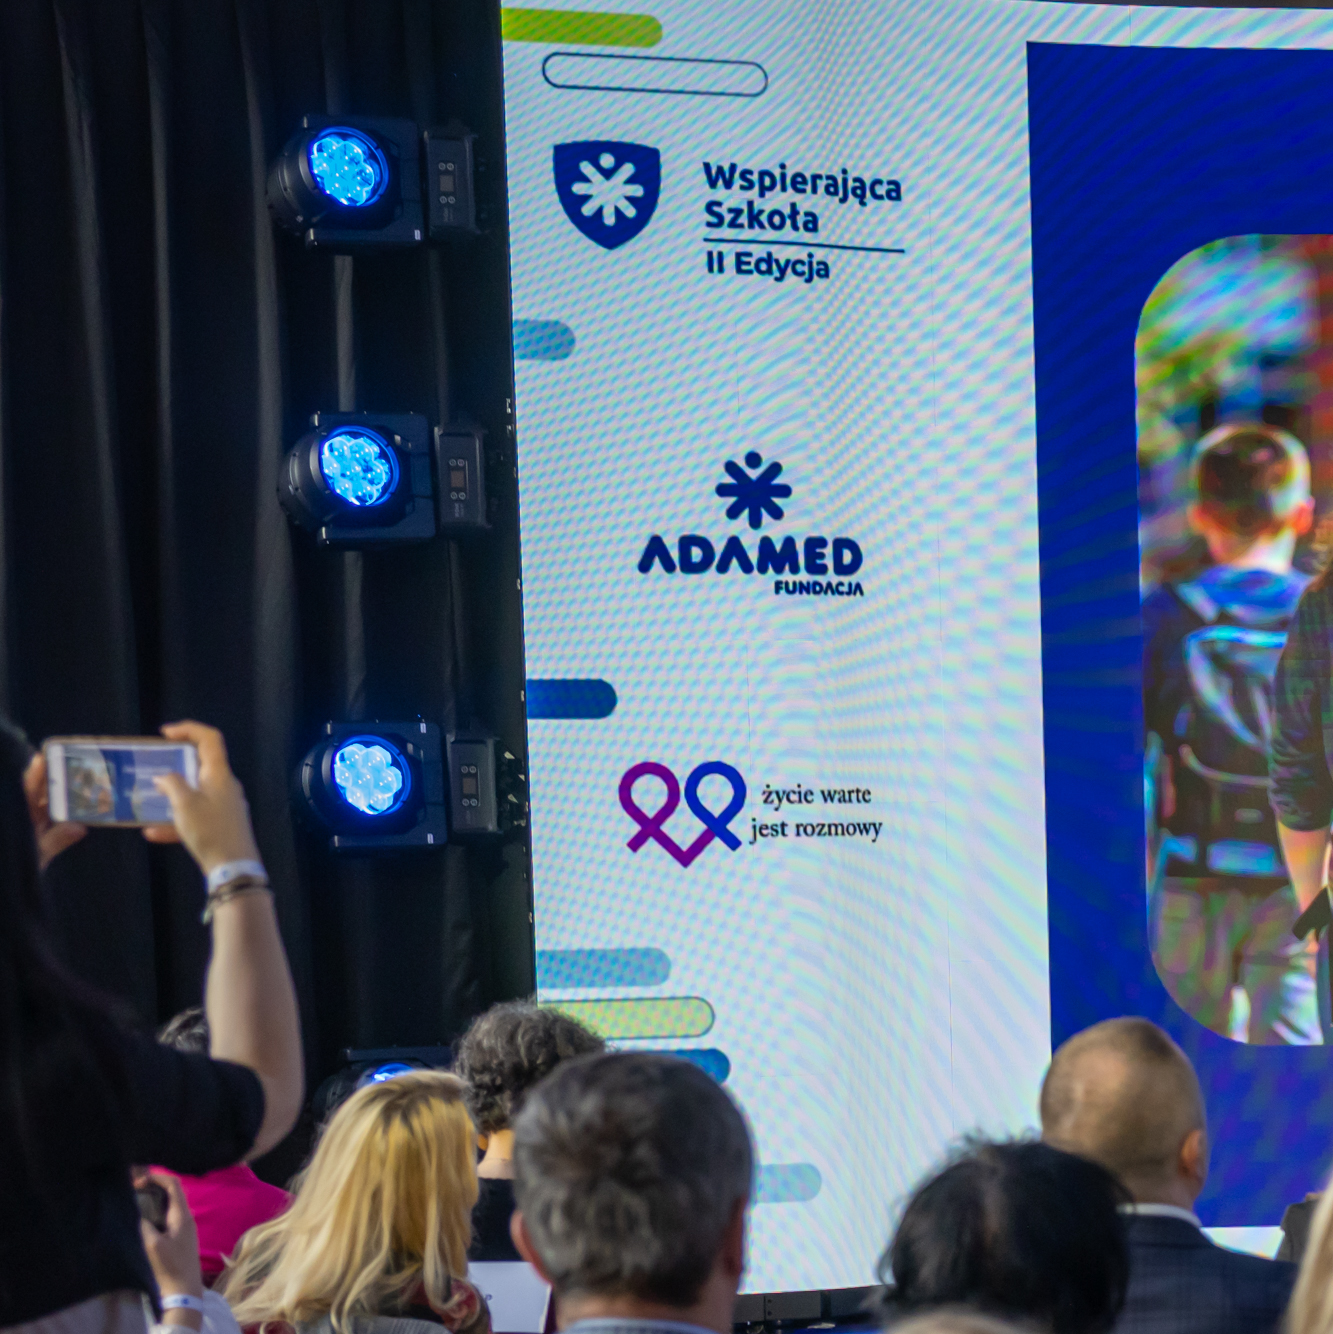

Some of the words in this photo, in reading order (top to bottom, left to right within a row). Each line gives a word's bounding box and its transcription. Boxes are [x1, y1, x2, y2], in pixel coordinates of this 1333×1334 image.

[702, 161, 902, 206] Wspierająca
[705, 200, 819, 233] Szkoła
[706, 251, 725, 274] II
[734, 252, 830, 283] Edycja
[637, 534, 863, 576] ADAMED
[774, 580, 864, 597] FUNDACJA
[761, 783, 814, 811] życie
[820, 786, 872, 804] warte
[748, 818, 788, 844] jest
[794, 821, 883, 842] rozmowy
